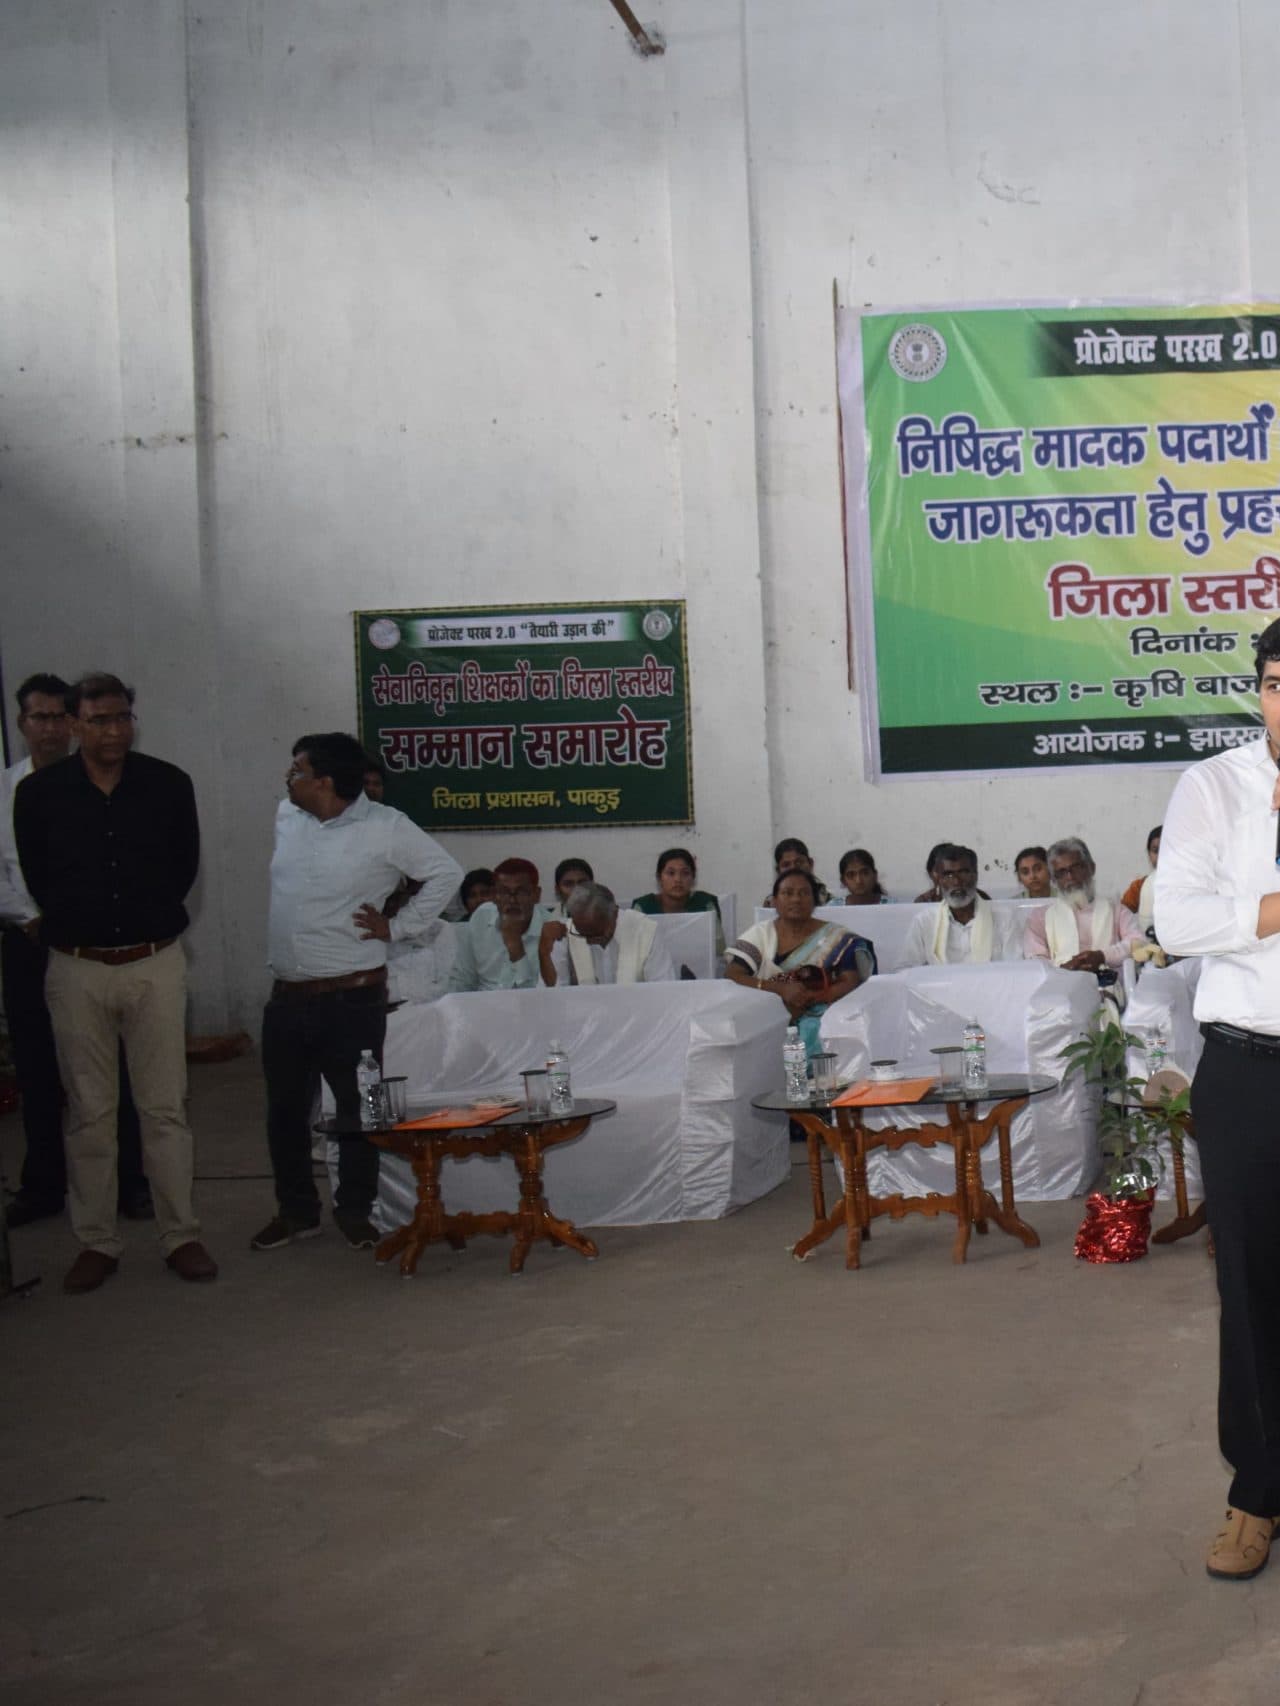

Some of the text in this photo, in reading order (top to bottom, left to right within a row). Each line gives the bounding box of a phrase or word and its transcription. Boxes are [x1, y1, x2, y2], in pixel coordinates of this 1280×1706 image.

[1074, 328, 1158, 365] प्रोजेक्ट
[1164, 334, 1223, 363] परख
[1232, 331, 1278, 361] 2.0
[898, 415, 1022, 475] निषिद्ध
[1033, 427, 1147, 469] मादक
[1158, 401, 1275, 464] पदार्थों
[925, 495, 1136, 543] जागरूकता
[1147, 477, 1210, 556] हेतु
[1047, 563, 1172, 620] जिला
[496, 626, 516, 640] 2.0
[1130, 626, 1239, 656] दिनांक
[461, 658, 528, 702] शिक्षकों
[531, 670, 558, 700] का
[562, 657, 612, 699] जिला
[615, 654, 674, 698] स्तरीय
[980, 681, 1060, 706] स्थल
[1114, 669, 1186, 708] कृषि
[379, 704, 671, 771] सम्मान समारोह
[1033, 725, 1146, 755] आयोजक
[432, 787, 481, 809] जिला
[568, 787, 621, 814] पाकुड़
